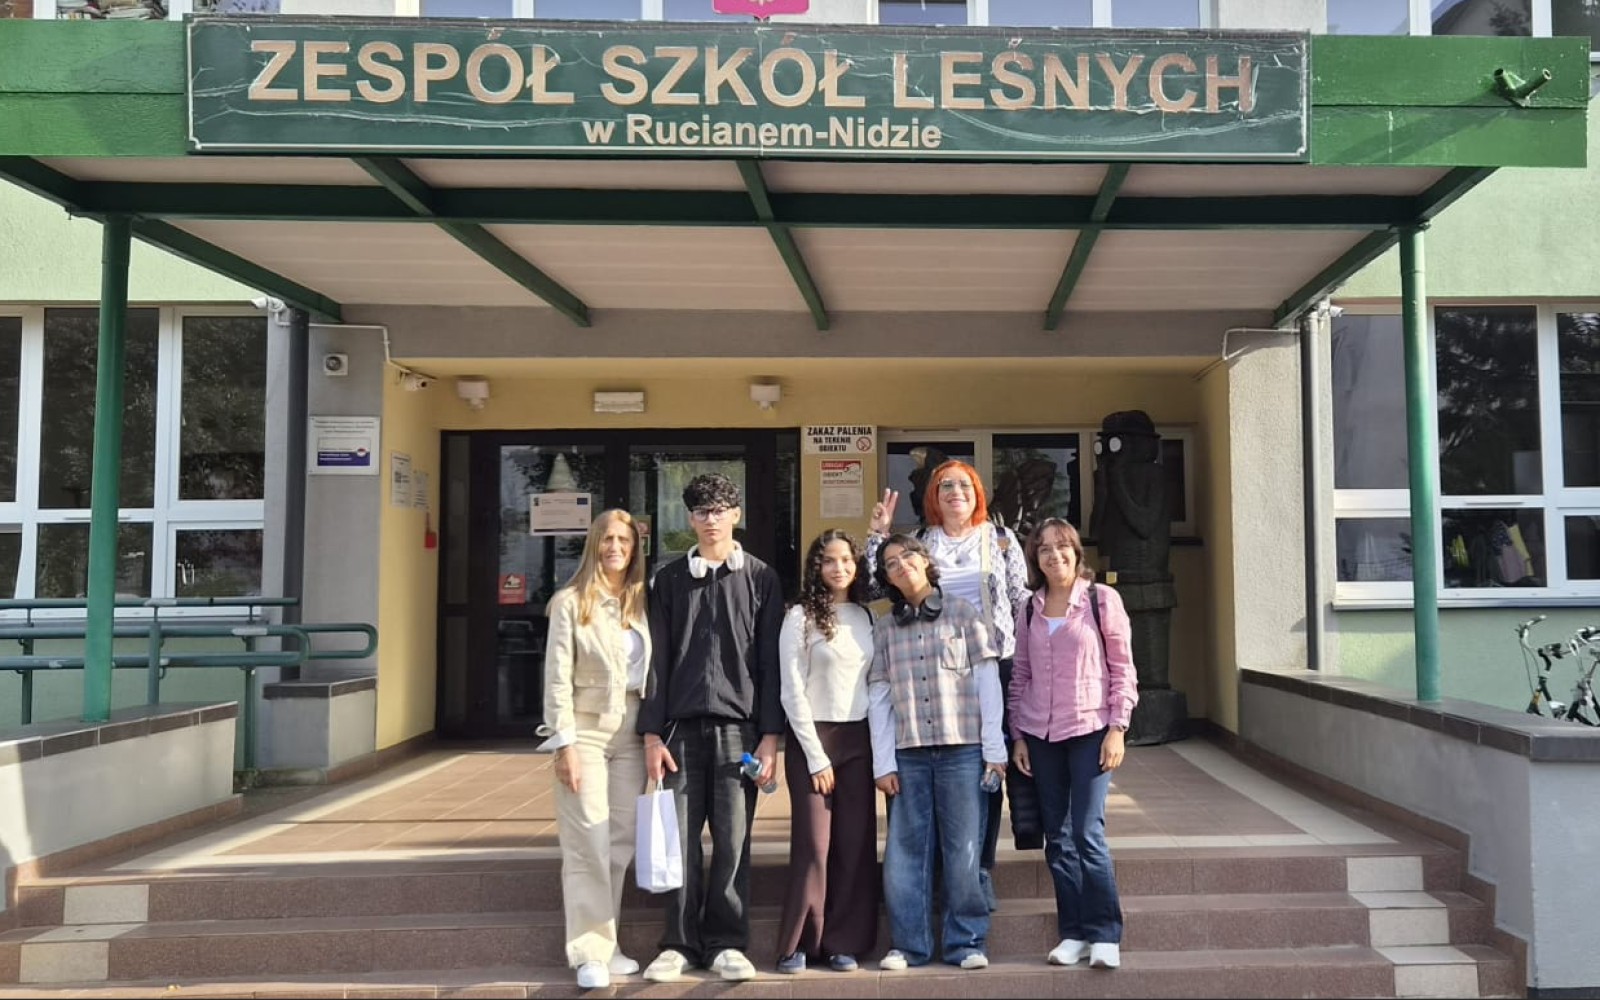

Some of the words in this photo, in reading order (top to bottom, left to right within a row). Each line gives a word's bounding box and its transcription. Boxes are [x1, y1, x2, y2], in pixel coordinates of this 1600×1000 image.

[247, 28, 575, 103] ZESPÓŁ
[600, 33, 866, 108] SZKÓŁ
[893, 38, 1253, 113] LEŚNYCH
[582, 120, 614, 143] w
[625, 113, 942, 148] Rucianem-Nidzie
[807, 426, 834, 436] ZAKAZ
[837, 426, 872, 436] PALENIA
